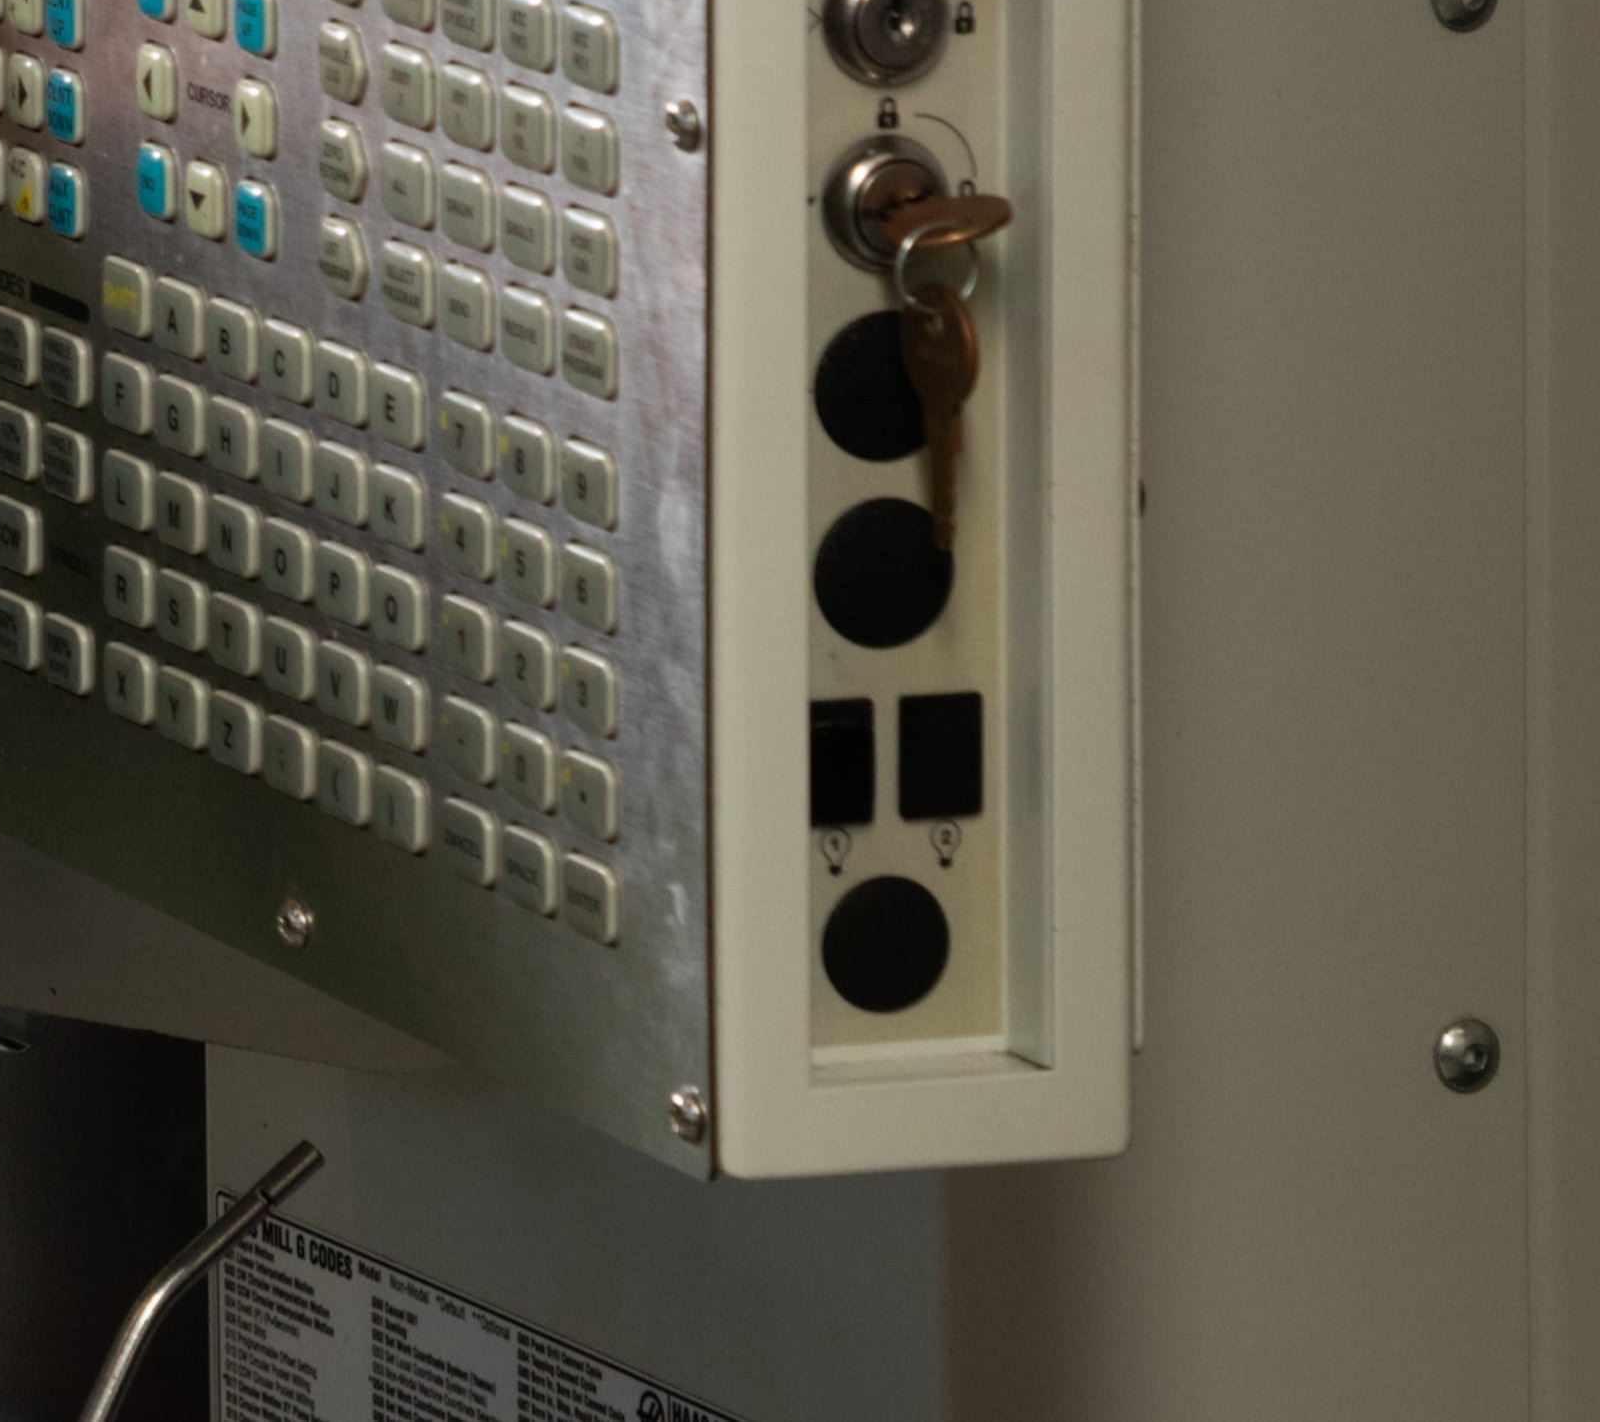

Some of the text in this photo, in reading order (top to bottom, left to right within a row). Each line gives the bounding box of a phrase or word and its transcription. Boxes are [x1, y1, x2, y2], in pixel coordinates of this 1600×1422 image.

[186, 81, 231, 113] CURSOR
[167, 308, 178, 336] A
[262, 1220, 352, 1280] MILL G CODES
